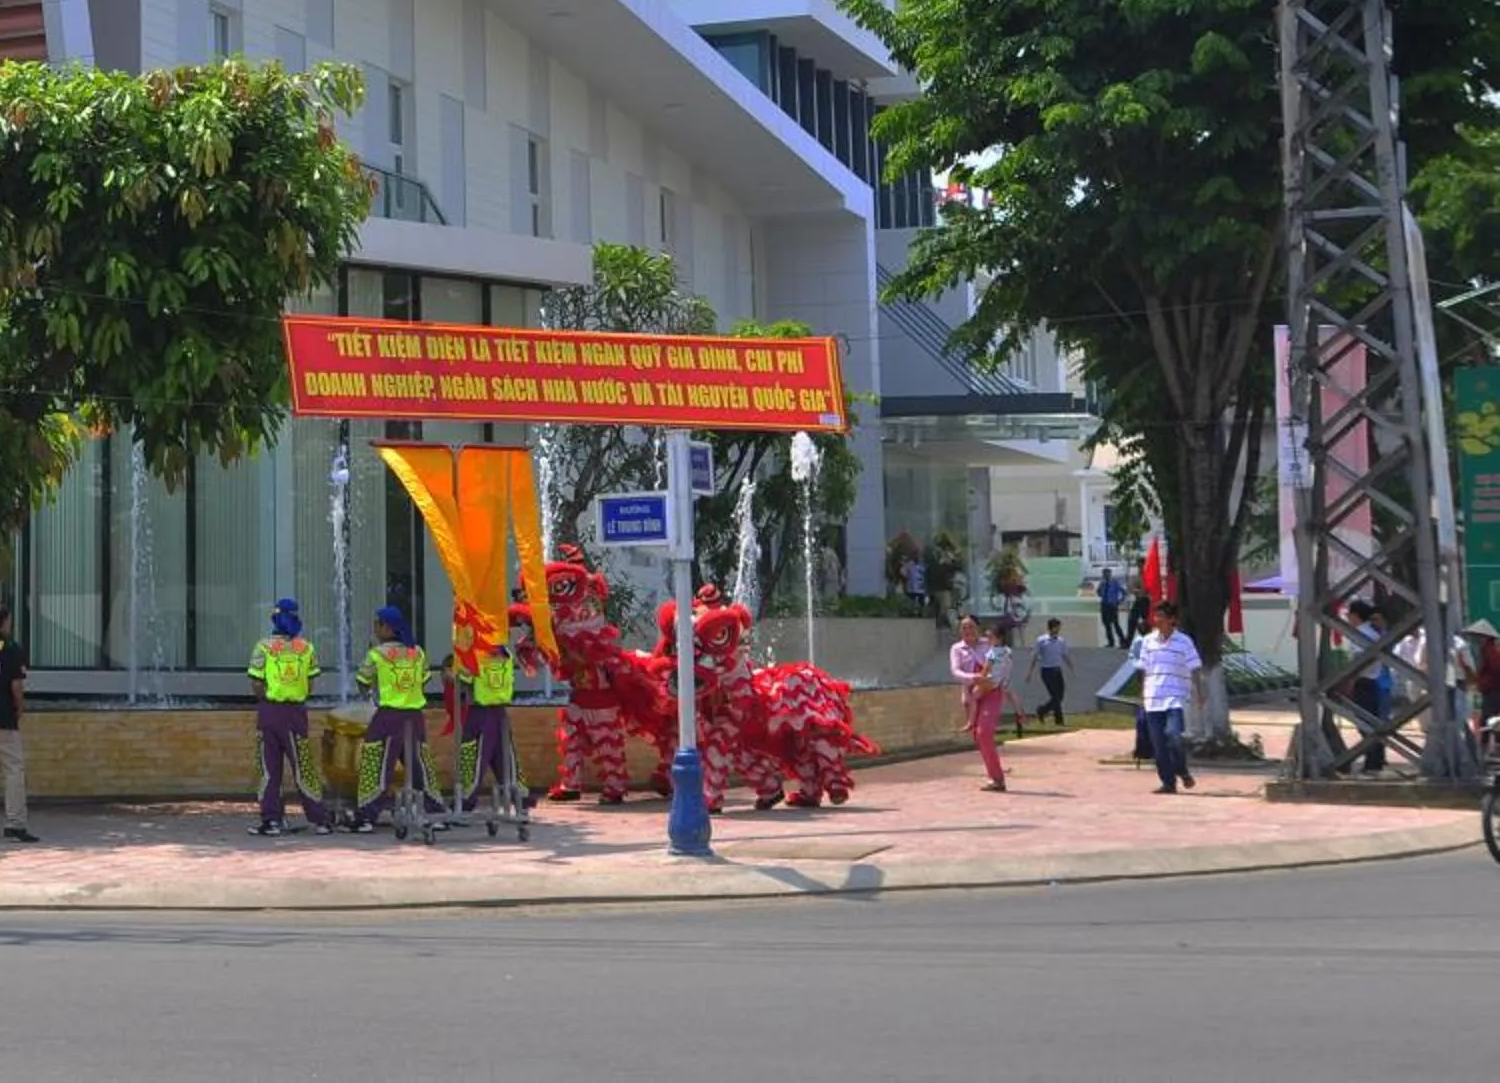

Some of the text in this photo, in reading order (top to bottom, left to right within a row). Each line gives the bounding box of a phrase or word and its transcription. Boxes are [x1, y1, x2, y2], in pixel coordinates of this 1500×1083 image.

[666, 345, 697, 370] GIA
[745, 348, 773, 373] CHI
[304, 371, 366, 397] DOANH
